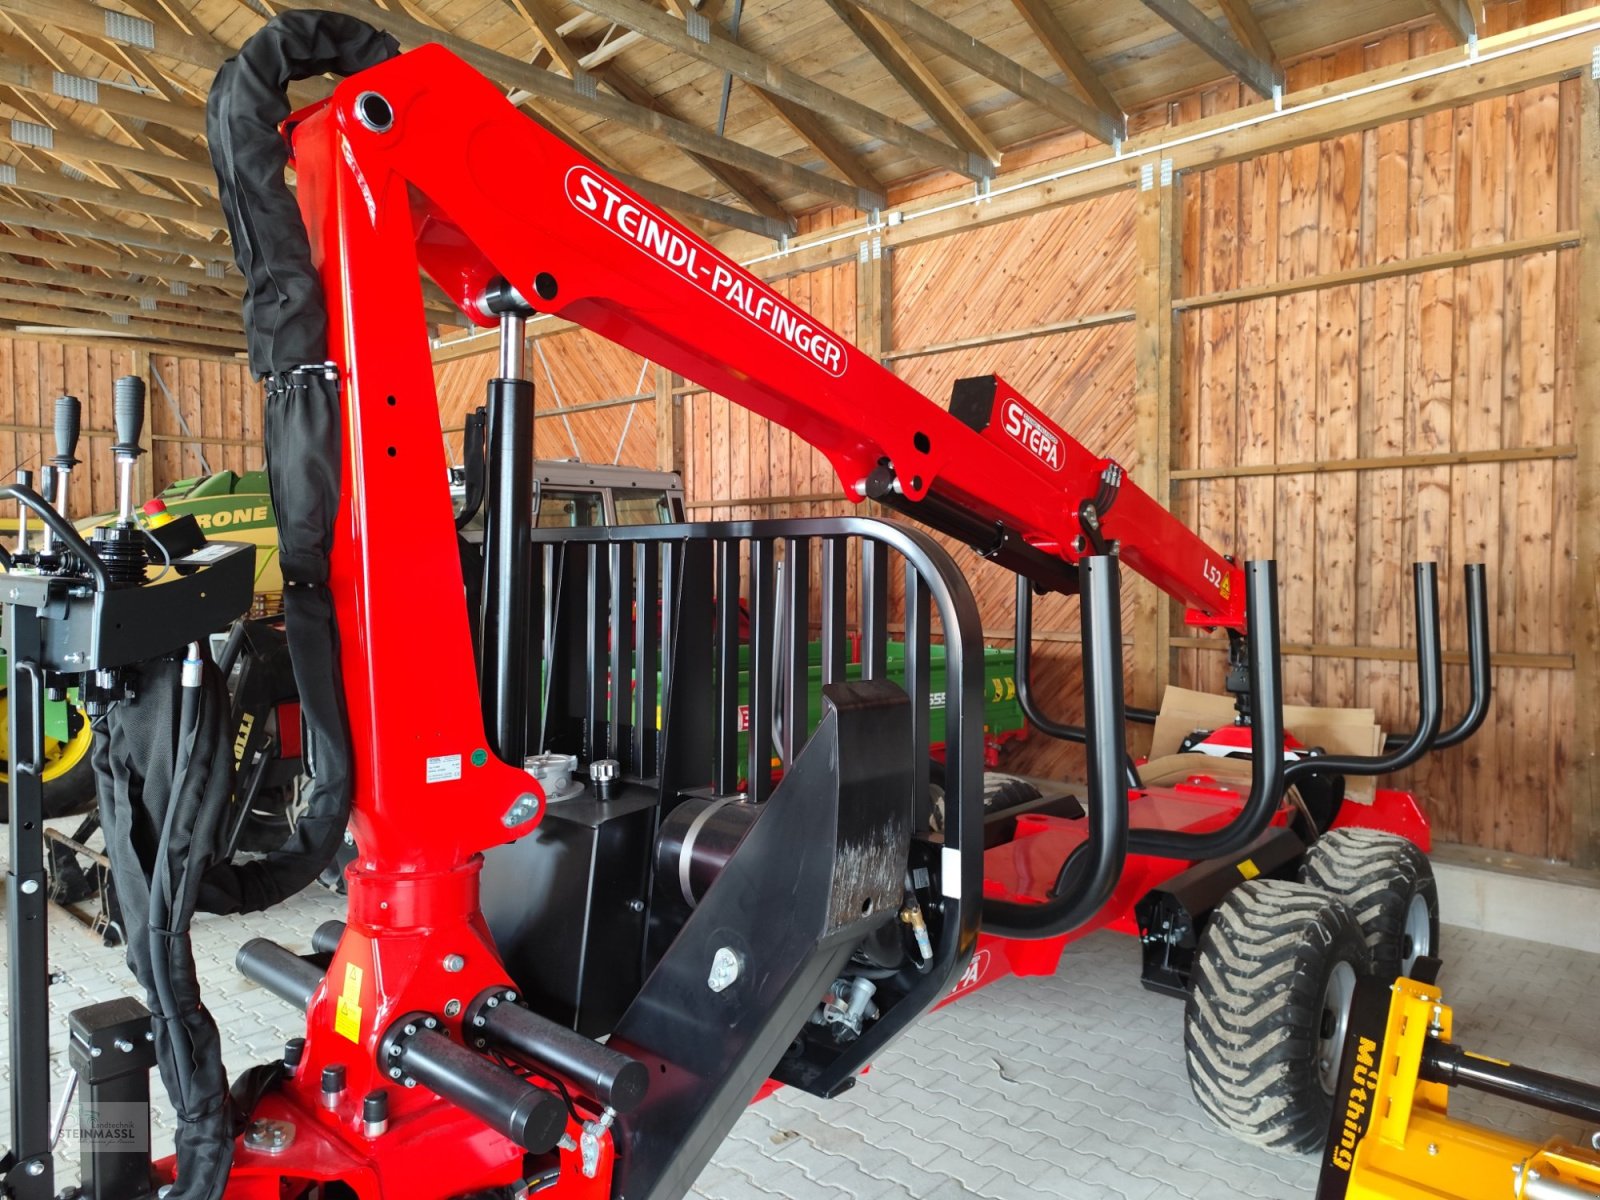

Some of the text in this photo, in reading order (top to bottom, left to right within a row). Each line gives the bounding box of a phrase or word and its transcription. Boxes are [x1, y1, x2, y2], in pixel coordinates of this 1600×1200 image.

[576, 174, 841, 372] STEINDL-PALFINGER
[1006, 403, 1058, 468] STEPA
[195, 506, 267, 529] RONE
[1332, 1036, 1378, 1171] Müthing
